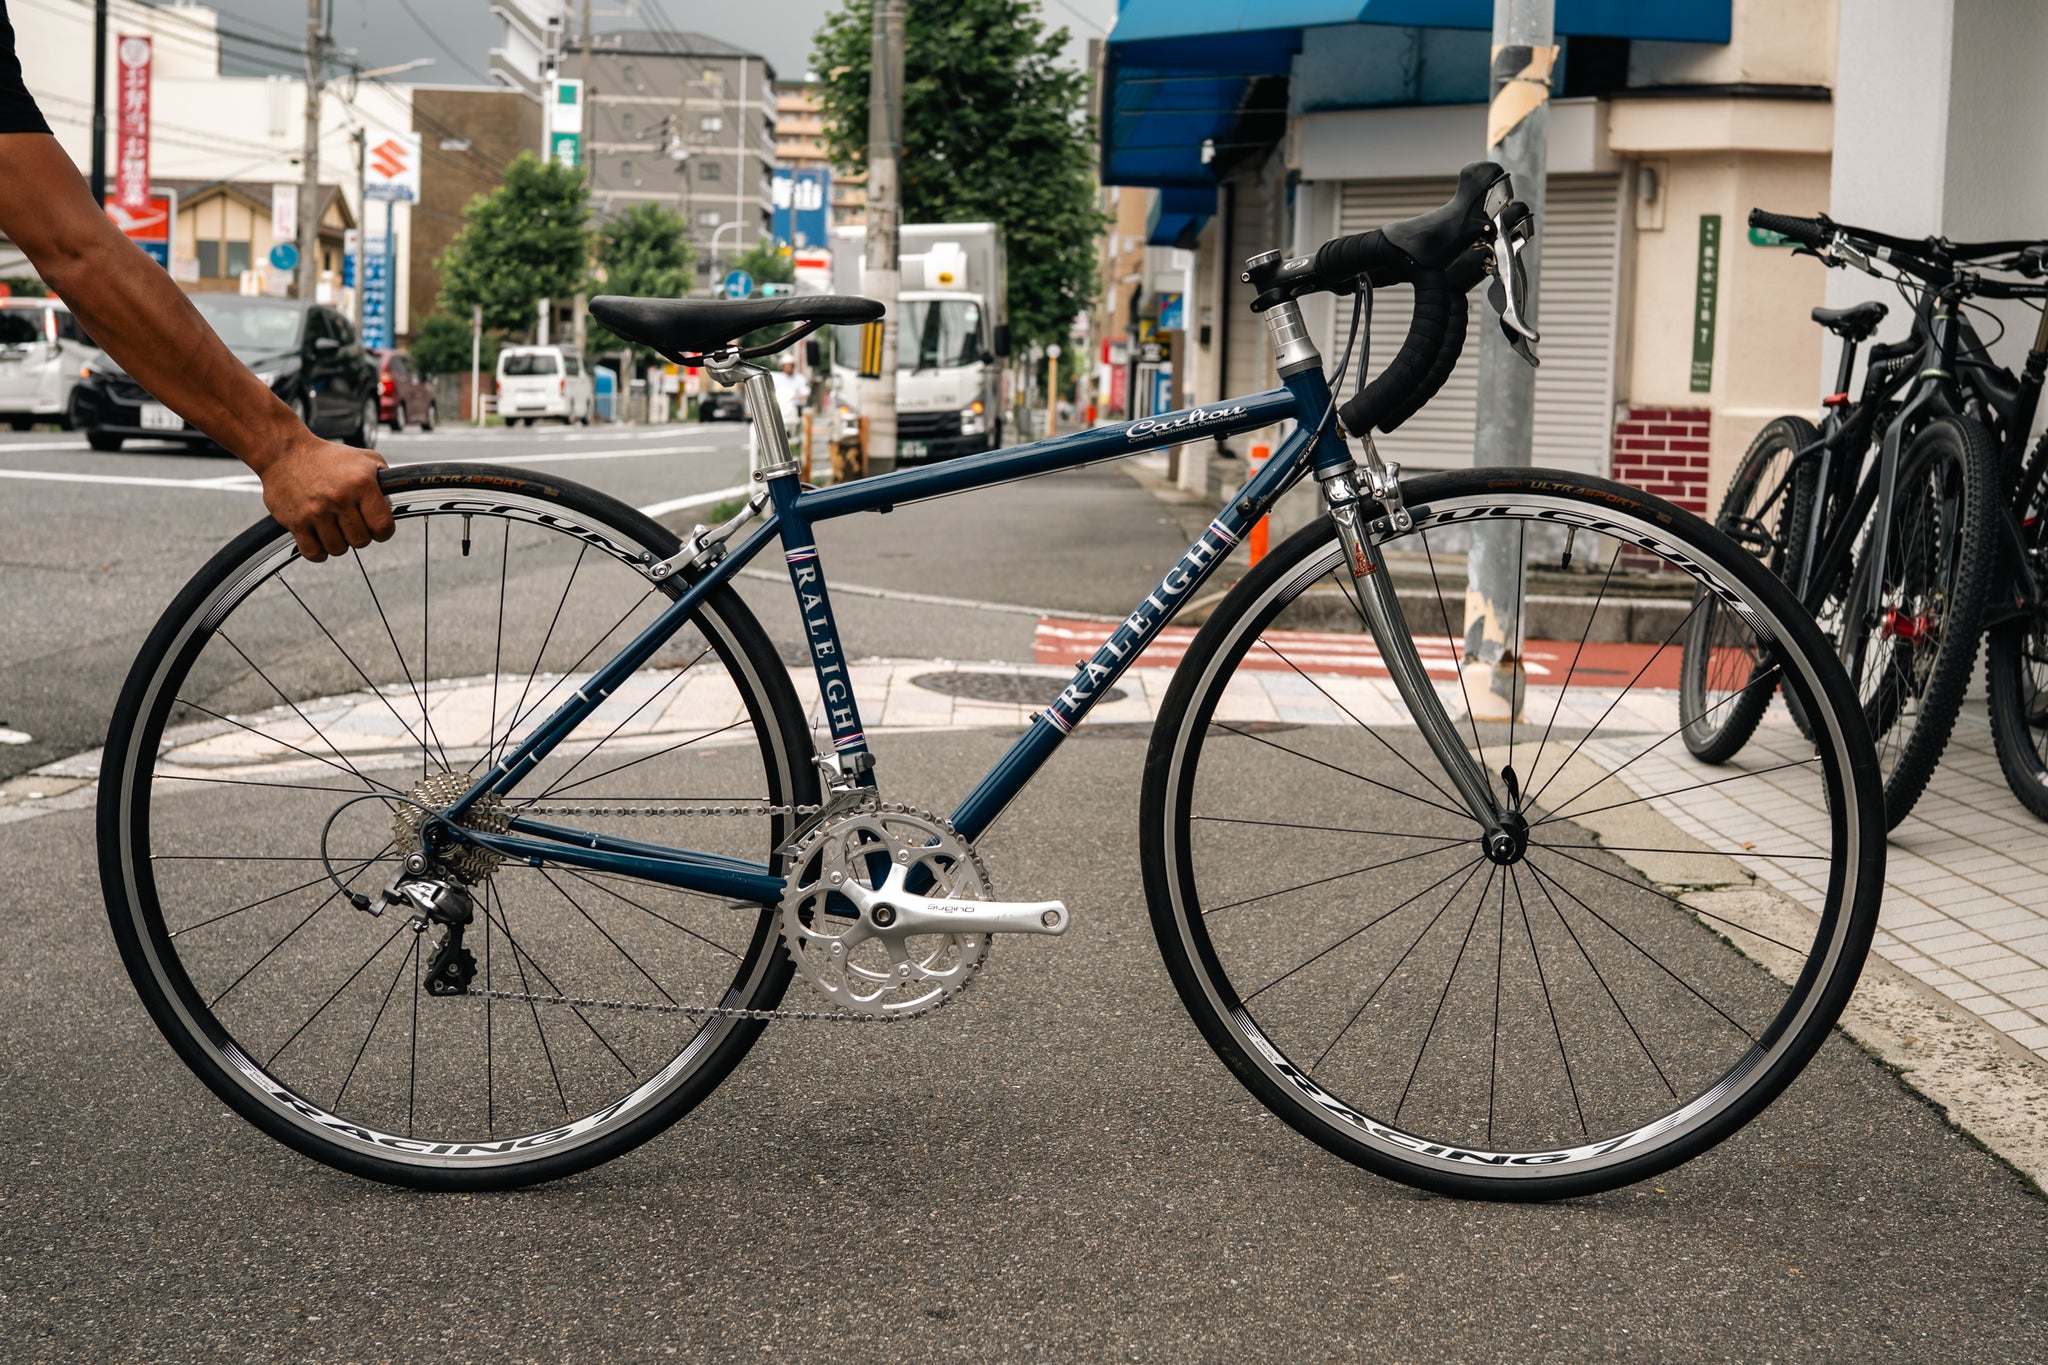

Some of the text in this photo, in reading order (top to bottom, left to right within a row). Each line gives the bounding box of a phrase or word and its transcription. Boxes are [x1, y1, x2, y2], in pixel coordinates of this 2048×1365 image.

[795, 564, 855, 732] RALEIGH
[1058, 536, 1220, 713] RALEIGH
[271, 1092, 574, 1154] RACING
[1274, 1063, 1570, 1165] RACING
